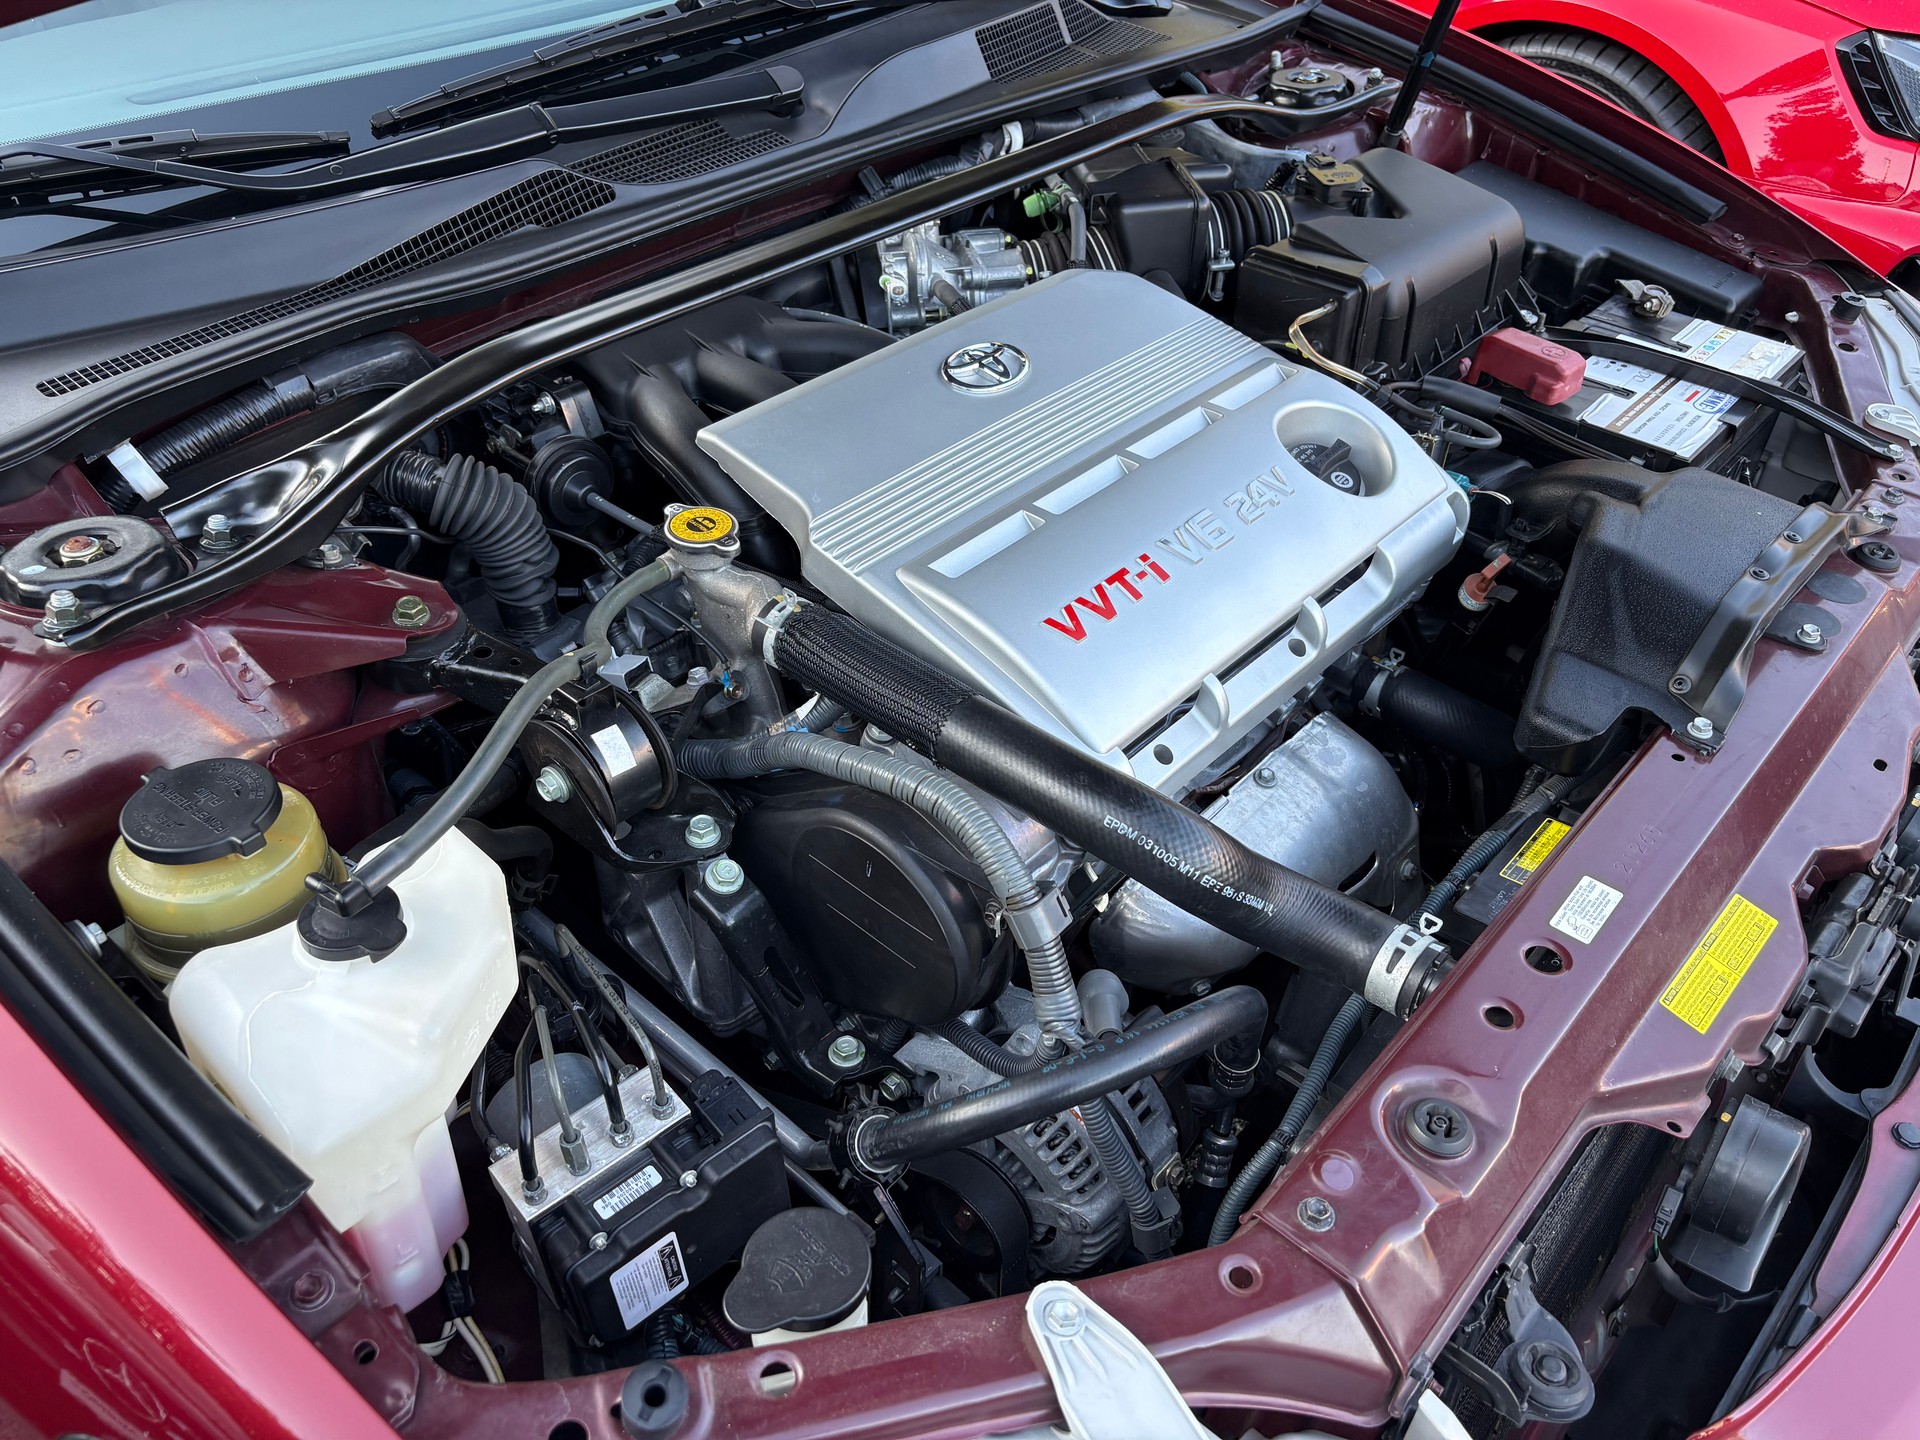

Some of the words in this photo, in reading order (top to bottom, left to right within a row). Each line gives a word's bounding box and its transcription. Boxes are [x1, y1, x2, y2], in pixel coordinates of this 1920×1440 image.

[1040, 553, 1171, 644] VVT-i
[1155, 507, 1235, 565] V6
[1223, 465, 1295, 525] 24V
[151, 782, 197, 813] STEERING
[193, 786, 226, 808] FLUID
[190, 810, 230, 835] POWER
[1103, 814, 1138, 841] EPDM
[1137, 835, 1179, 867] 031005
[1177, 860, 1201, 881] M11
[1613, 823, 1663, 874] 21265
